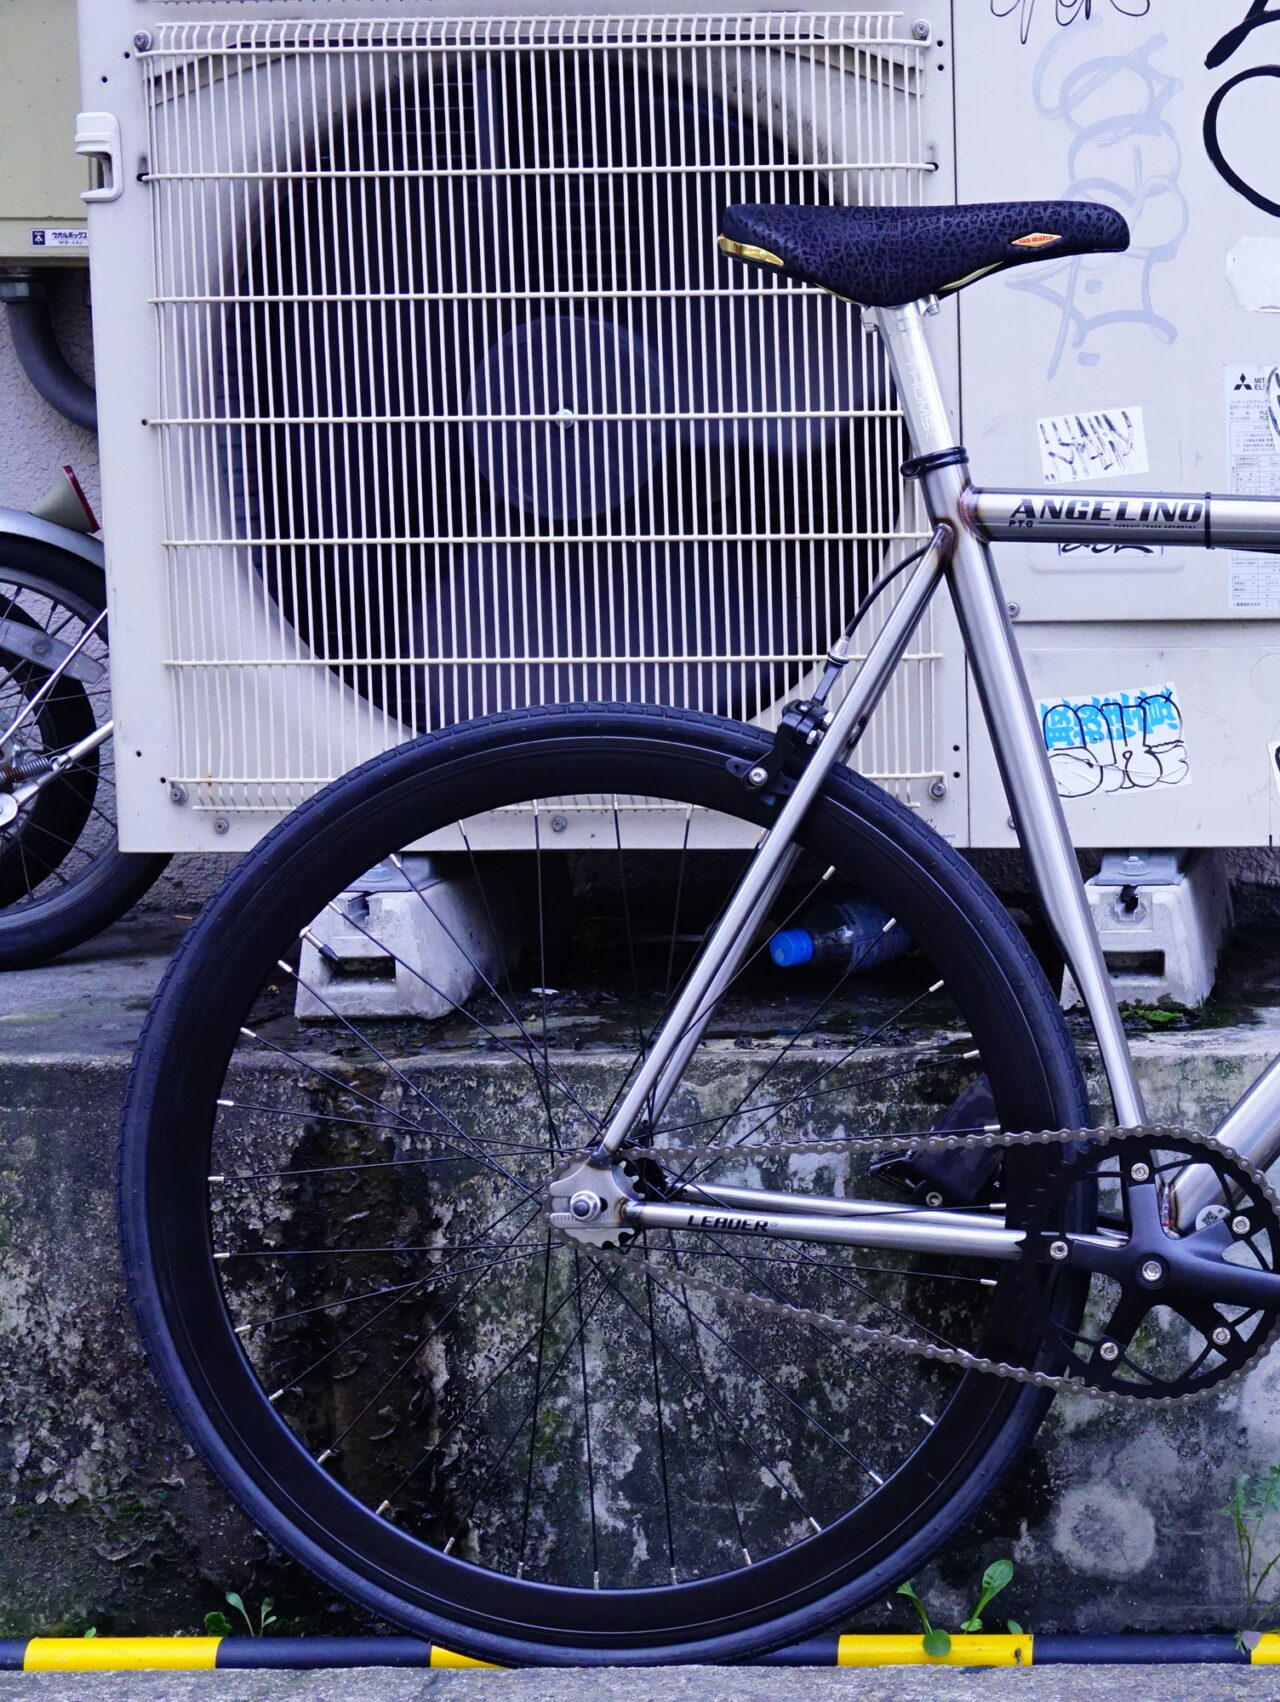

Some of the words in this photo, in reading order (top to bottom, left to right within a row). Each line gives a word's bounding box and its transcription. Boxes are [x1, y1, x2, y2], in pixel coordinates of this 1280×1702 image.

[1010, 498, 1204, 523] ANGELINO
[1008, 520, 1034, 528] PTG
[687, 1215, 769, 1232] LEADER
